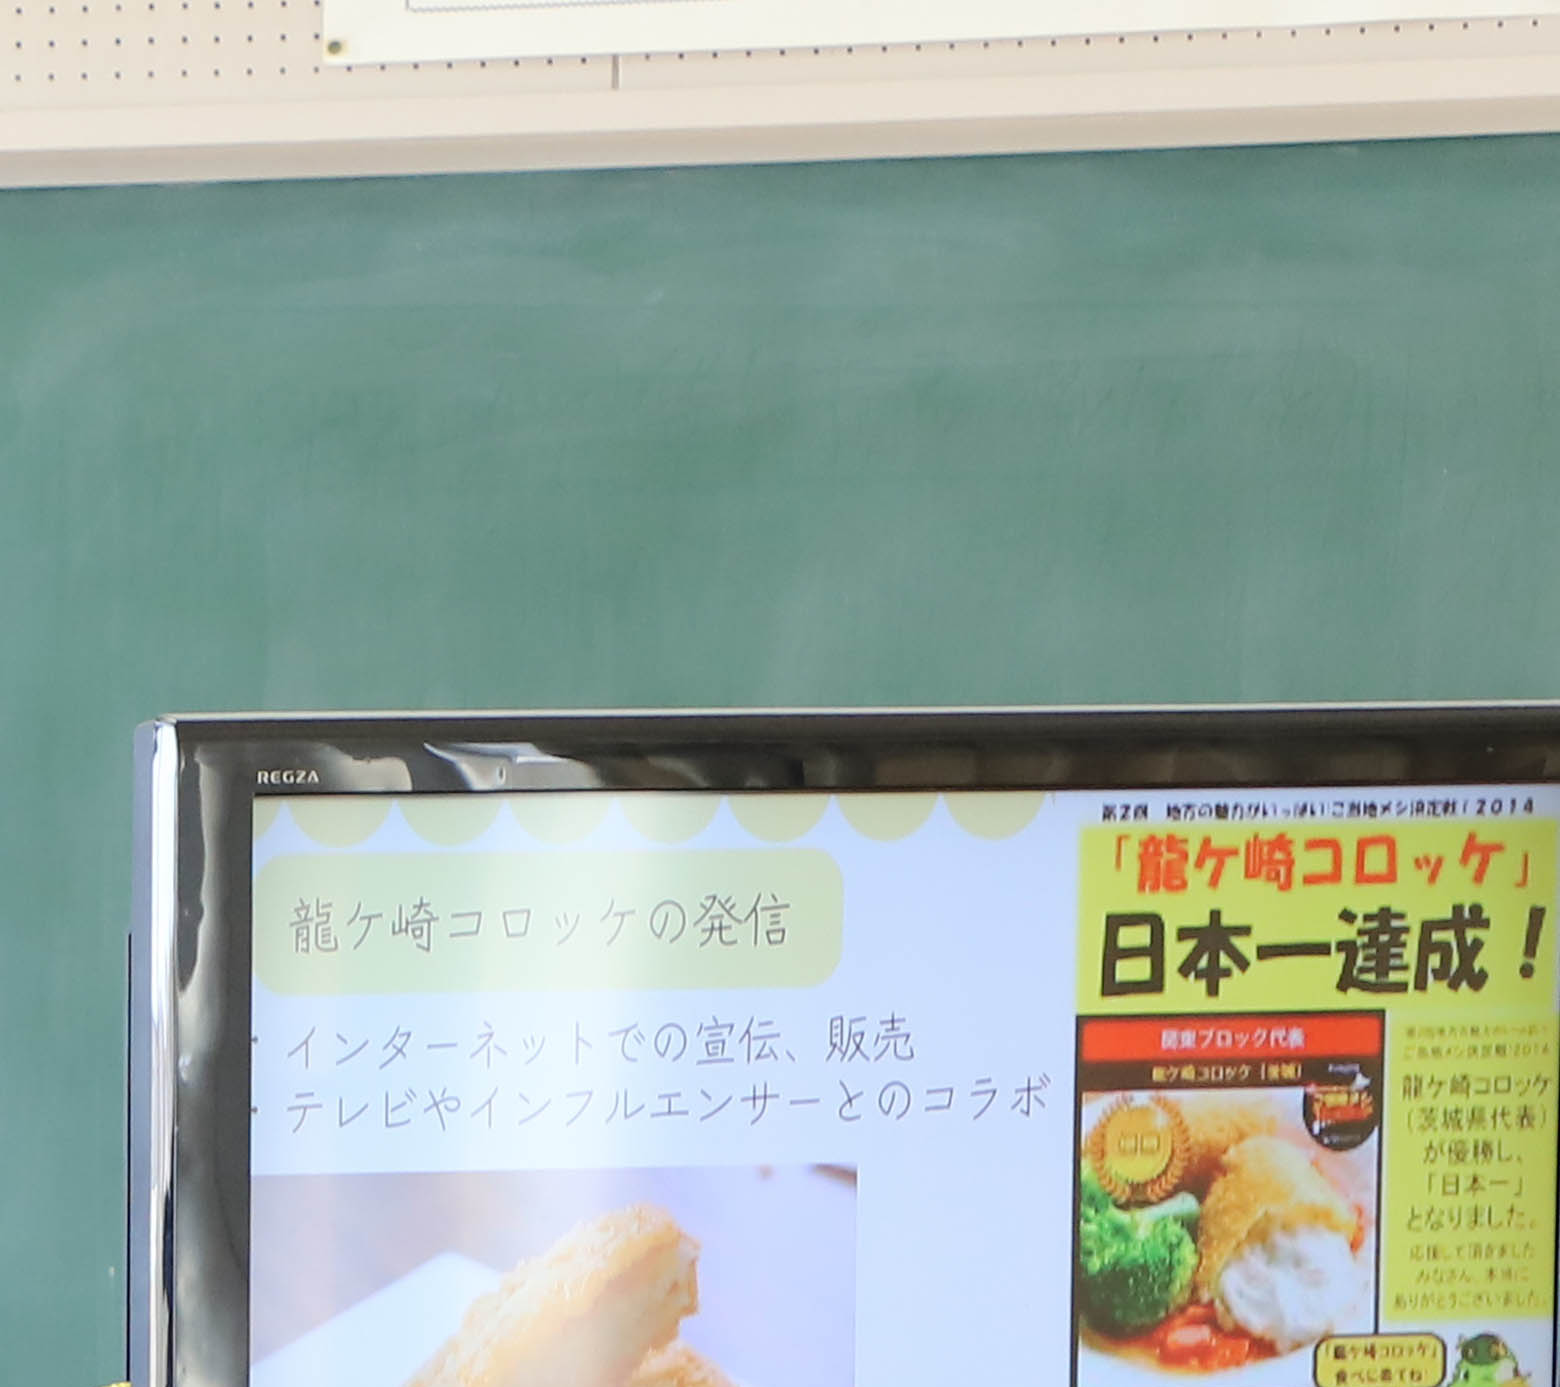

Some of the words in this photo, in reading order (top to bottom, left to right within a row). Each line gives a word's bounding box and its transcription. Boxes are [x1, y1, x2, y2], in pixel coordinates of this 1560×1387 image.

[257, 770, 319, 784] REGZA
[1101, 903, 1546, 998] 日本一達成！
[286, 1073, 1052, 1134] テレビやインフルエンサーとのコラボ
[1426, 1174, 1524, 1198] 「日本一」
[1406, 1207, 1537, 1232] となりました。
